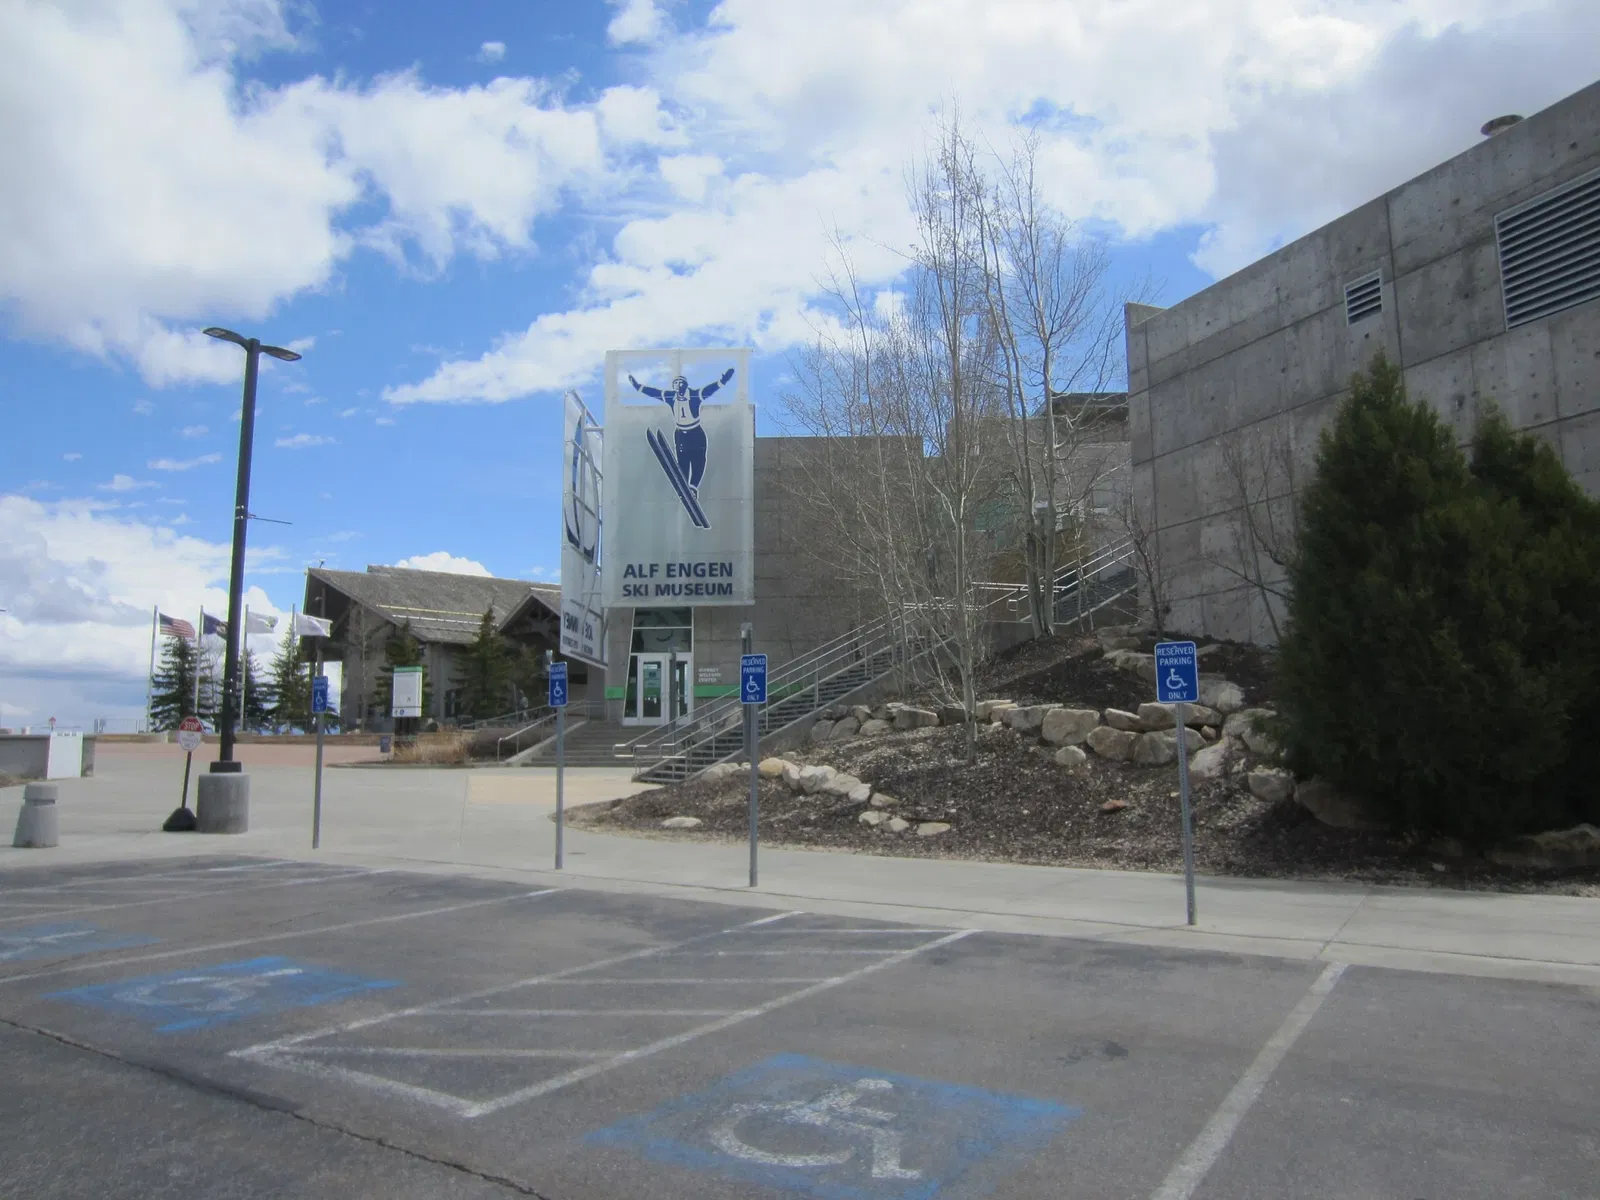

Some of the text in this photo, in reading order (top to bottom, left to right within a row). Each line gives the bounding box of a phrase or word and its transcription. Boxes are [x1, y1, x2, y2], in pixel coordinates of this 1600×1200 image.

[623, 562, 733, 578] ALF ENGEN
[622, 582, 733, 597] SKI MUSEUM
[1157, 647, 1193, 656] RESERVED
[741, 657, 766, 665] RESERVED
[1160, 657, 1192, 666] PARKING
[743, 666, 765, 674] PARKING
[1168, 691, 1188, 699] ONLY
[184, 721, 200, 730] STOP
